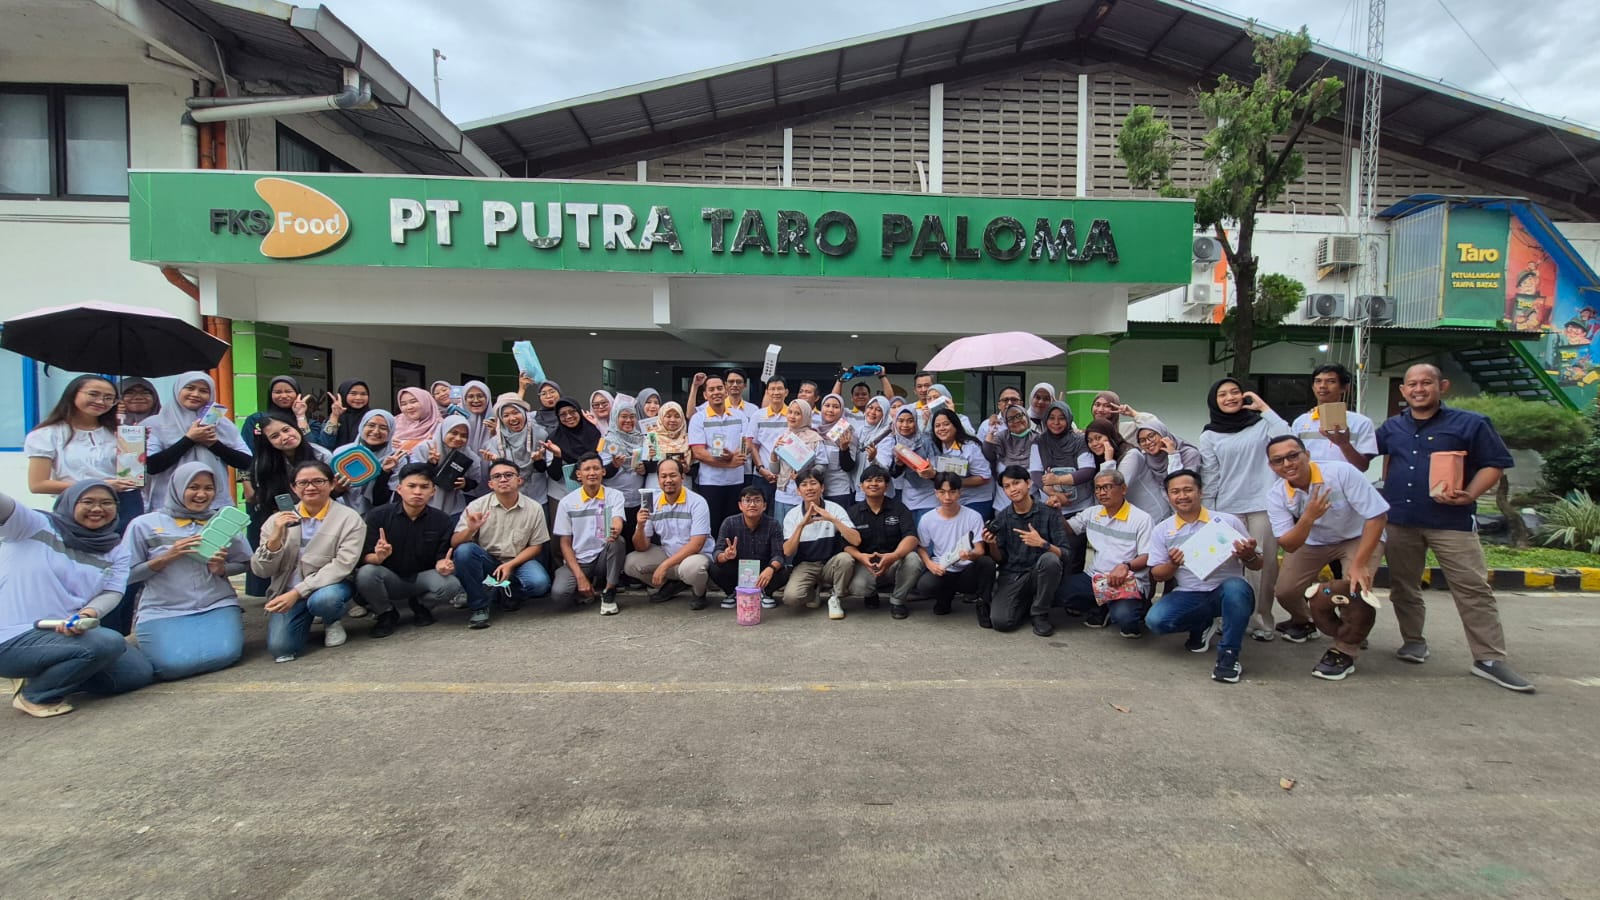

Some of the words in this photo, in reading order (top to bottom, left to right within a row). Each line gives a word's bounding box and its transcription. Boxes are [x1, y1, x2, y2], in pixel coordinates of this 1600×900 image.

[209, 208, 271, 236] FKS
[278, 211, 340, 235] Food
[389, 198, 460, 245] PT
[482, 200, 682, 251] PUTRA
[701, 207, 858, 256] TARO
[882, 213, 1119, 264] PALOMA
[1457, 243, 1499, 262] Taro
